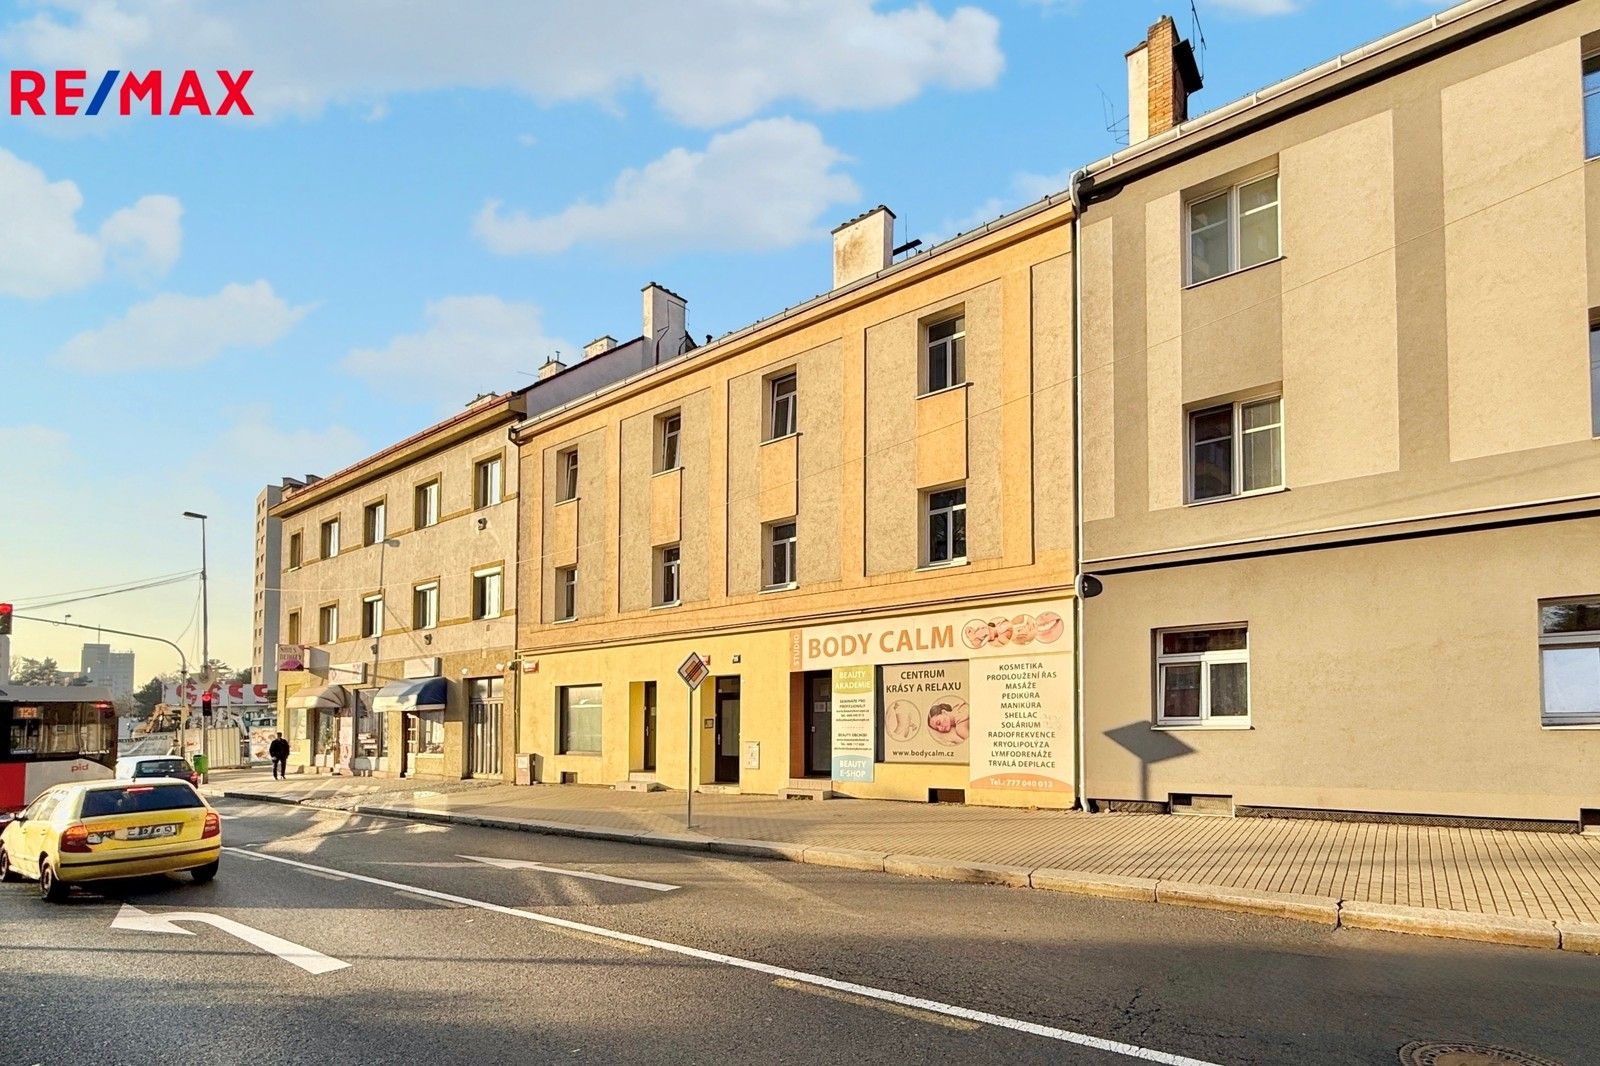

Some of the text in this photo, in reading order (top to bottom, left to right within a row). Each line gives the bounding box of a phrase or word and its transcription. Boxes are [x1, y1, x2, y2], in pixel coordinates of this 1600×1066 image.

[808, 625, 954, 658] BODY CALM
[999, 662, 1043, 671] KOSMETIKA
[839, 670, 866, 679] BEAUTY
[900, 669, 945, 680] CENTRUM
[986, 671, 1040, 681] PRODLOUŽENÍ
[835, 680, 871, 690] AKADEMIE
[886, 682, 962, 693] KRÁSY A RELAXU
[1005, 682, 1037, 690] MASÁŽE
[1004, 711, 1038, 719] SHELLAC
[1001, 721, 1041, 729] SOLÁRIUM
[987, 731, 1056, 739] RADIOFREKVENCE
[892, 749, 955, 758] www.bodycalm.cz
[71, 763, 89, 773] pid
[839, 760, 866, 769] BEAUTY
[1018, 760, 1056, 769] DEPILACE
[839, 769, 866, 778] E-SHOP
